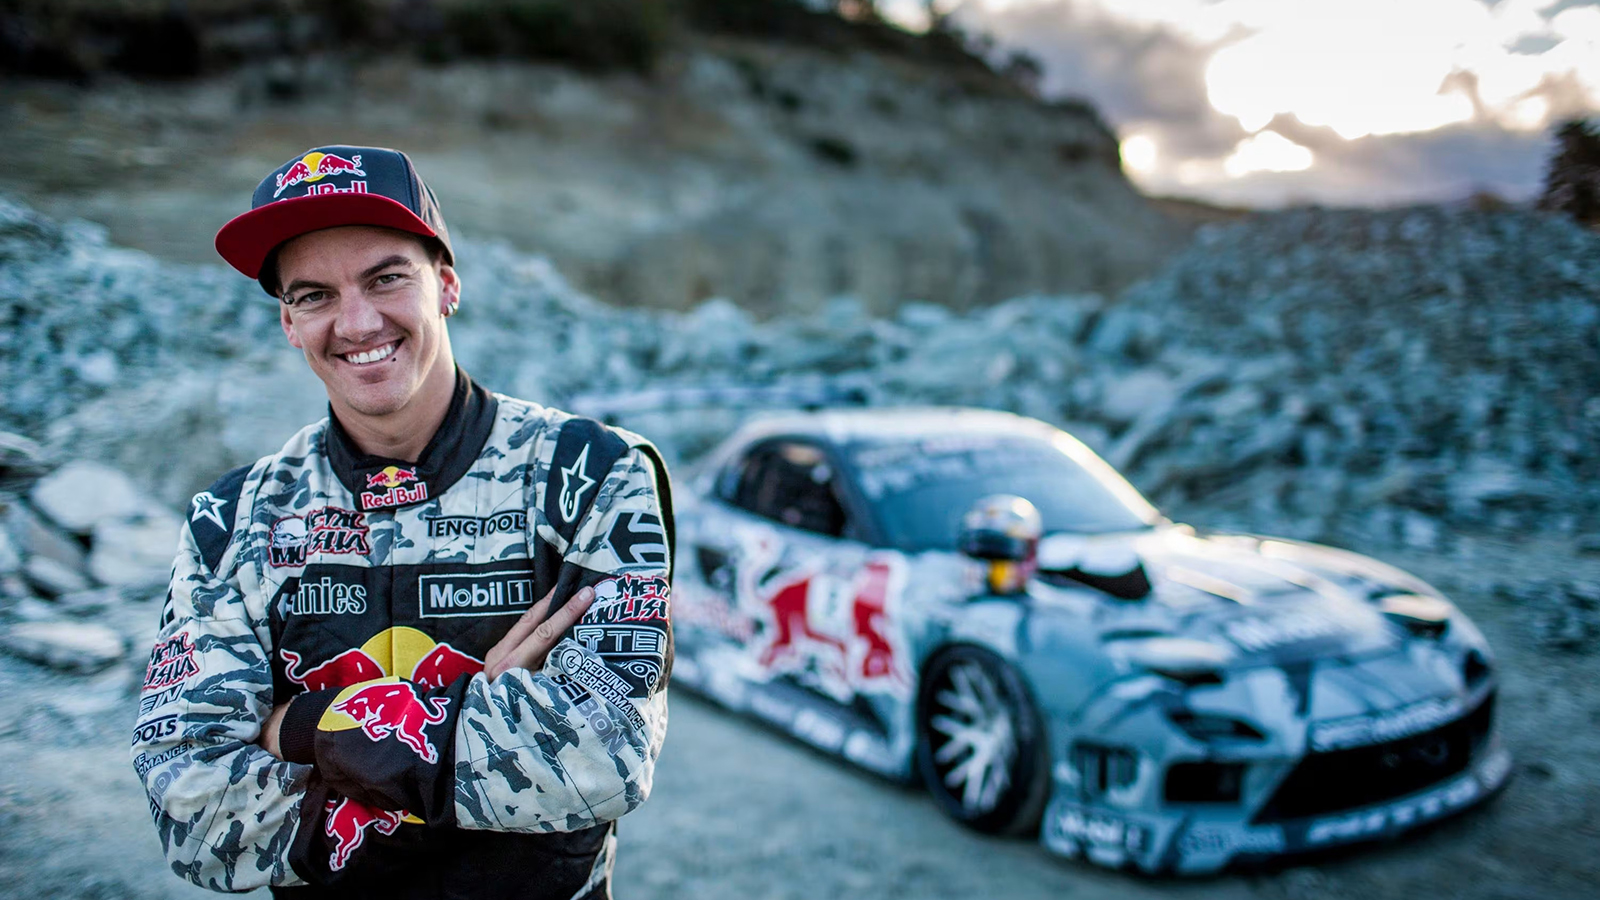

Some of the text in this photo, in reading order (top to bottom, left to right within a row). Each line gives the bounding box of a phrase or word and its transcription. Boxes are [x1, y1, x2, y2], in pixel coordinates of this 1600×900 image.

[361, 482, 428, 510] Red Bull
[304, 506, 368, 531] ETAL
[430, 582, 504, 608] Mobil
[580, 657, 632, 697] REDLINE
[550, 673, 628, 757] SEIBON
[576, 669, 646, 732] PERFORMANCE
